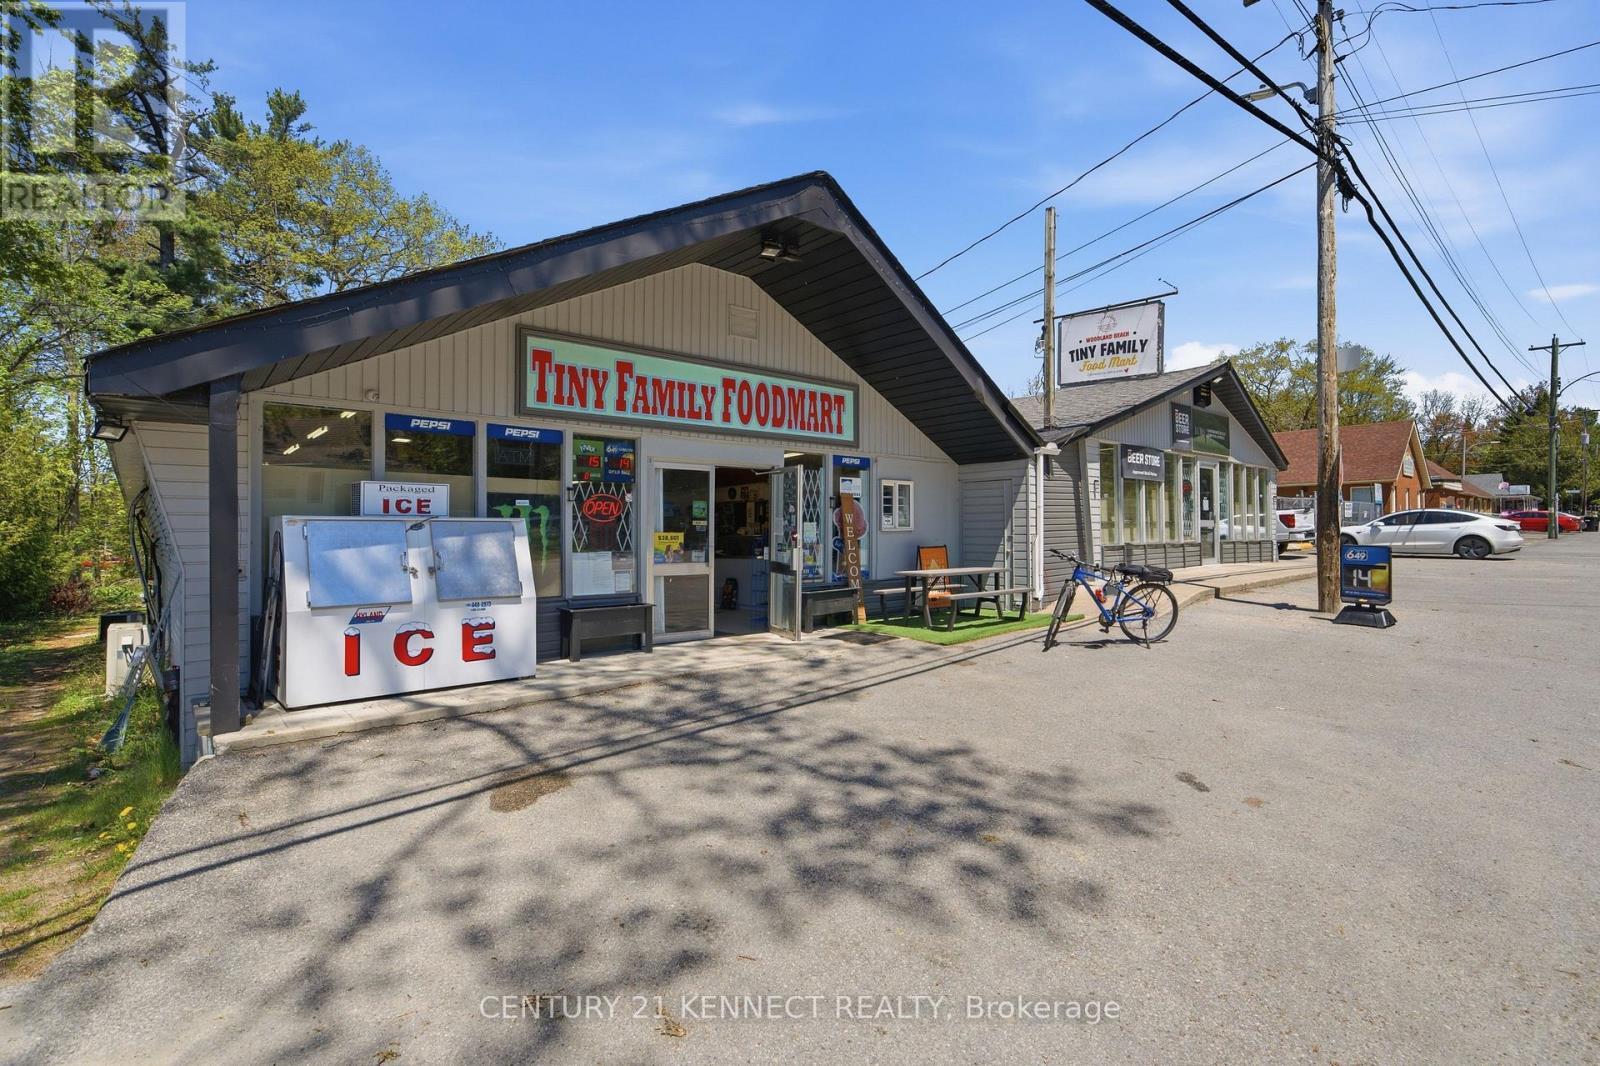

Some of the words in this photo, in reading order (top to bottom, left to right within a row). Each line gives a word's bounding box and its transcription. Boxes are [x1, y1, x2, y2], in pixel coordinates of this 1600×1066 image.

[1086, 334, 1112, 343] WOODLAND
[1114, 331, 1129, 339] BEACH
[1069, 345, 1097, 363] TINY
[1101, 339, 1149, 357] FAMILY
[1079, 358, 1106, 372] Food
[1108, 354, 1138, 369] Mart
[721, 377, 846, 435] FOODMART
[410, 418, 451, 431] PEPSI
[1174, 411, 1189, 424] BEER
[504, 427, 540, 439] PEPSI
[1175, 423, 1190, 435] STORE
[841, 457, 861, 465] PEPSI
[1127, 451, 1144, 465] BEER
[1144, 454, 1161, 467] STORE
[378, 484, 436, 495] Packaged
[382, 498, 431, 514] ICE
[585, 500, 620, 516] OPEN
[1352, 569, 1372, 588] 14
[343, 616, 497, 677] ICE
